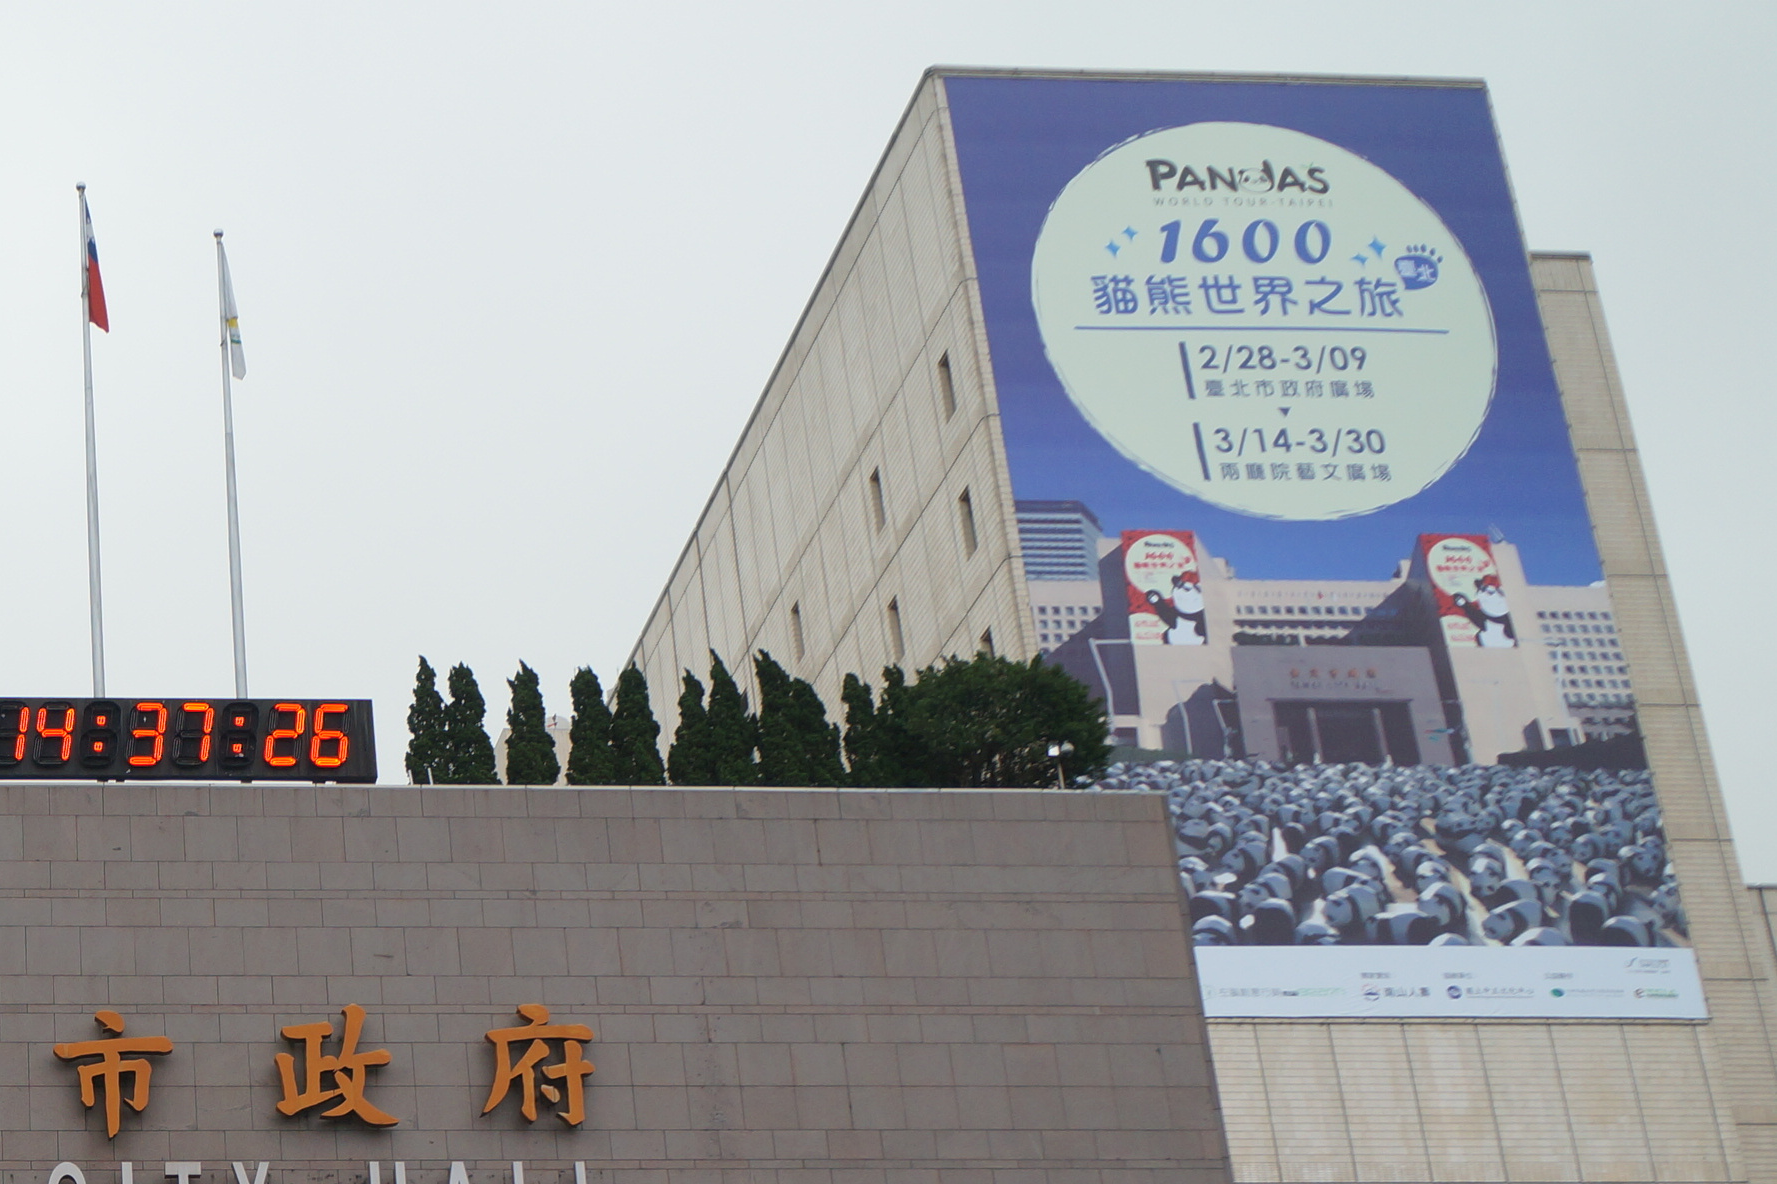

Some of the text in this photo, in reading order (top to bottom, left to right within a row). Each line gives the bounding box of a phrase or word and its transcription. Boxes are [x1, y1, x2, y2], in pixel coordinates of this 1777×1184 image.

[1145, 158, 1330, 194] PANDAS
[1153, 196, 1214, 207] WORLD
[1158, 218, 1332, 265] 1600
[1090, 274, 1404, 317] 貓熊世界之旅
[1198, 344, 1368, 374] 2/28-3/09
[1204, 379, 1375, 399] 臺北市政府廣場
[1213, 427, 1386, 457] 3/14-3/30
[15, 701, 349, 767] 14:37:26
